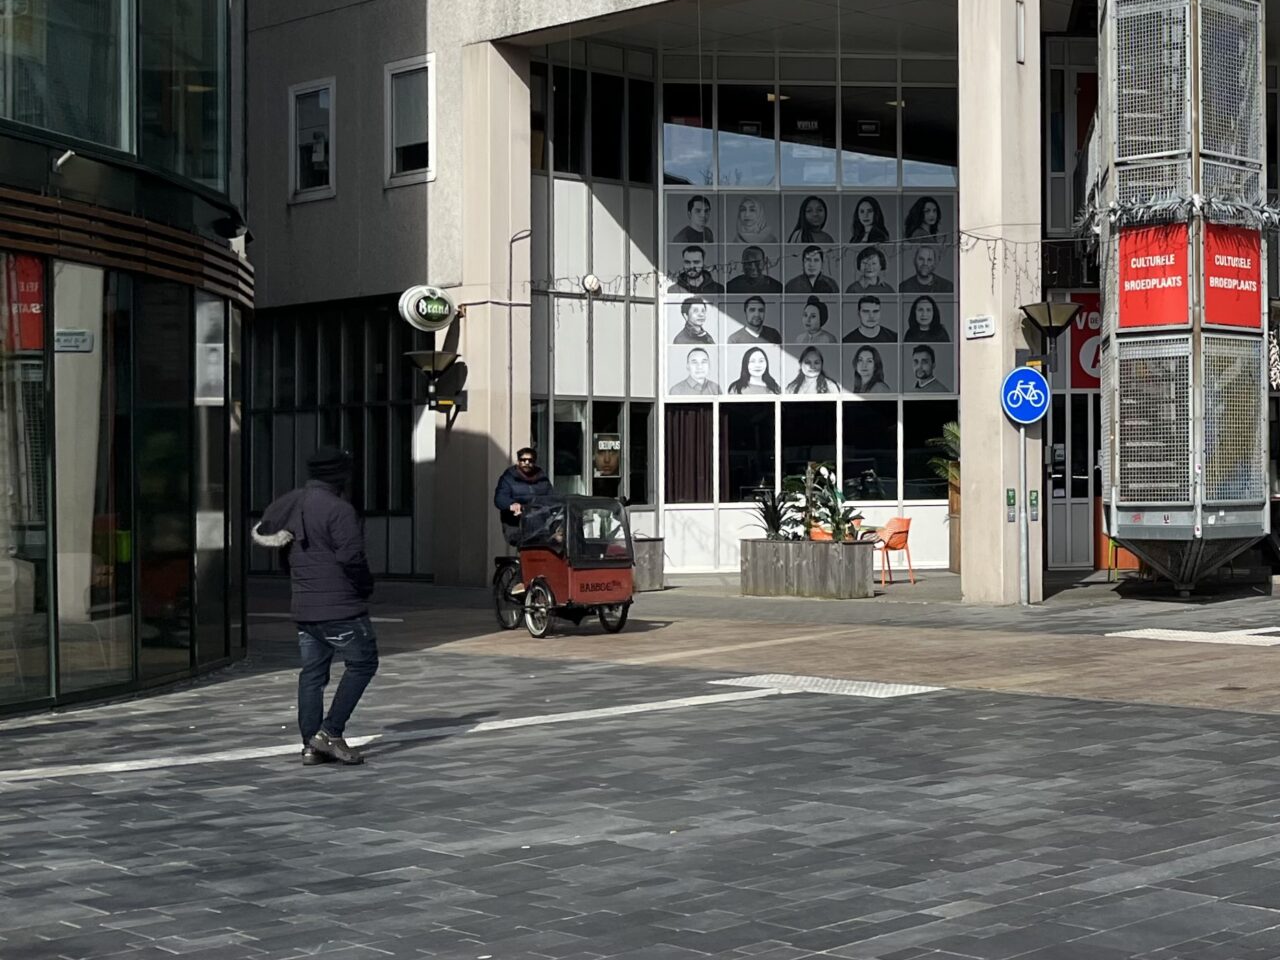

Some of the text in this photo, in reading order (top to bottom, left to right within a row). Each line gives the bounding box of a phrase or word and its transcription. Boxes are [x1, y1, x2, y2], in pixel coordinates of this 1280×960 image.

[1131, 254, 1175, 269] CULTURELE
[1215, 254, 1252, 269] CULTURELE
[1124, 275, 1183, 291] BROEDPLAATS
[1209, 276, 1258, 292] BROEDPLAATS
[418, 298, 450, 315] Brand
